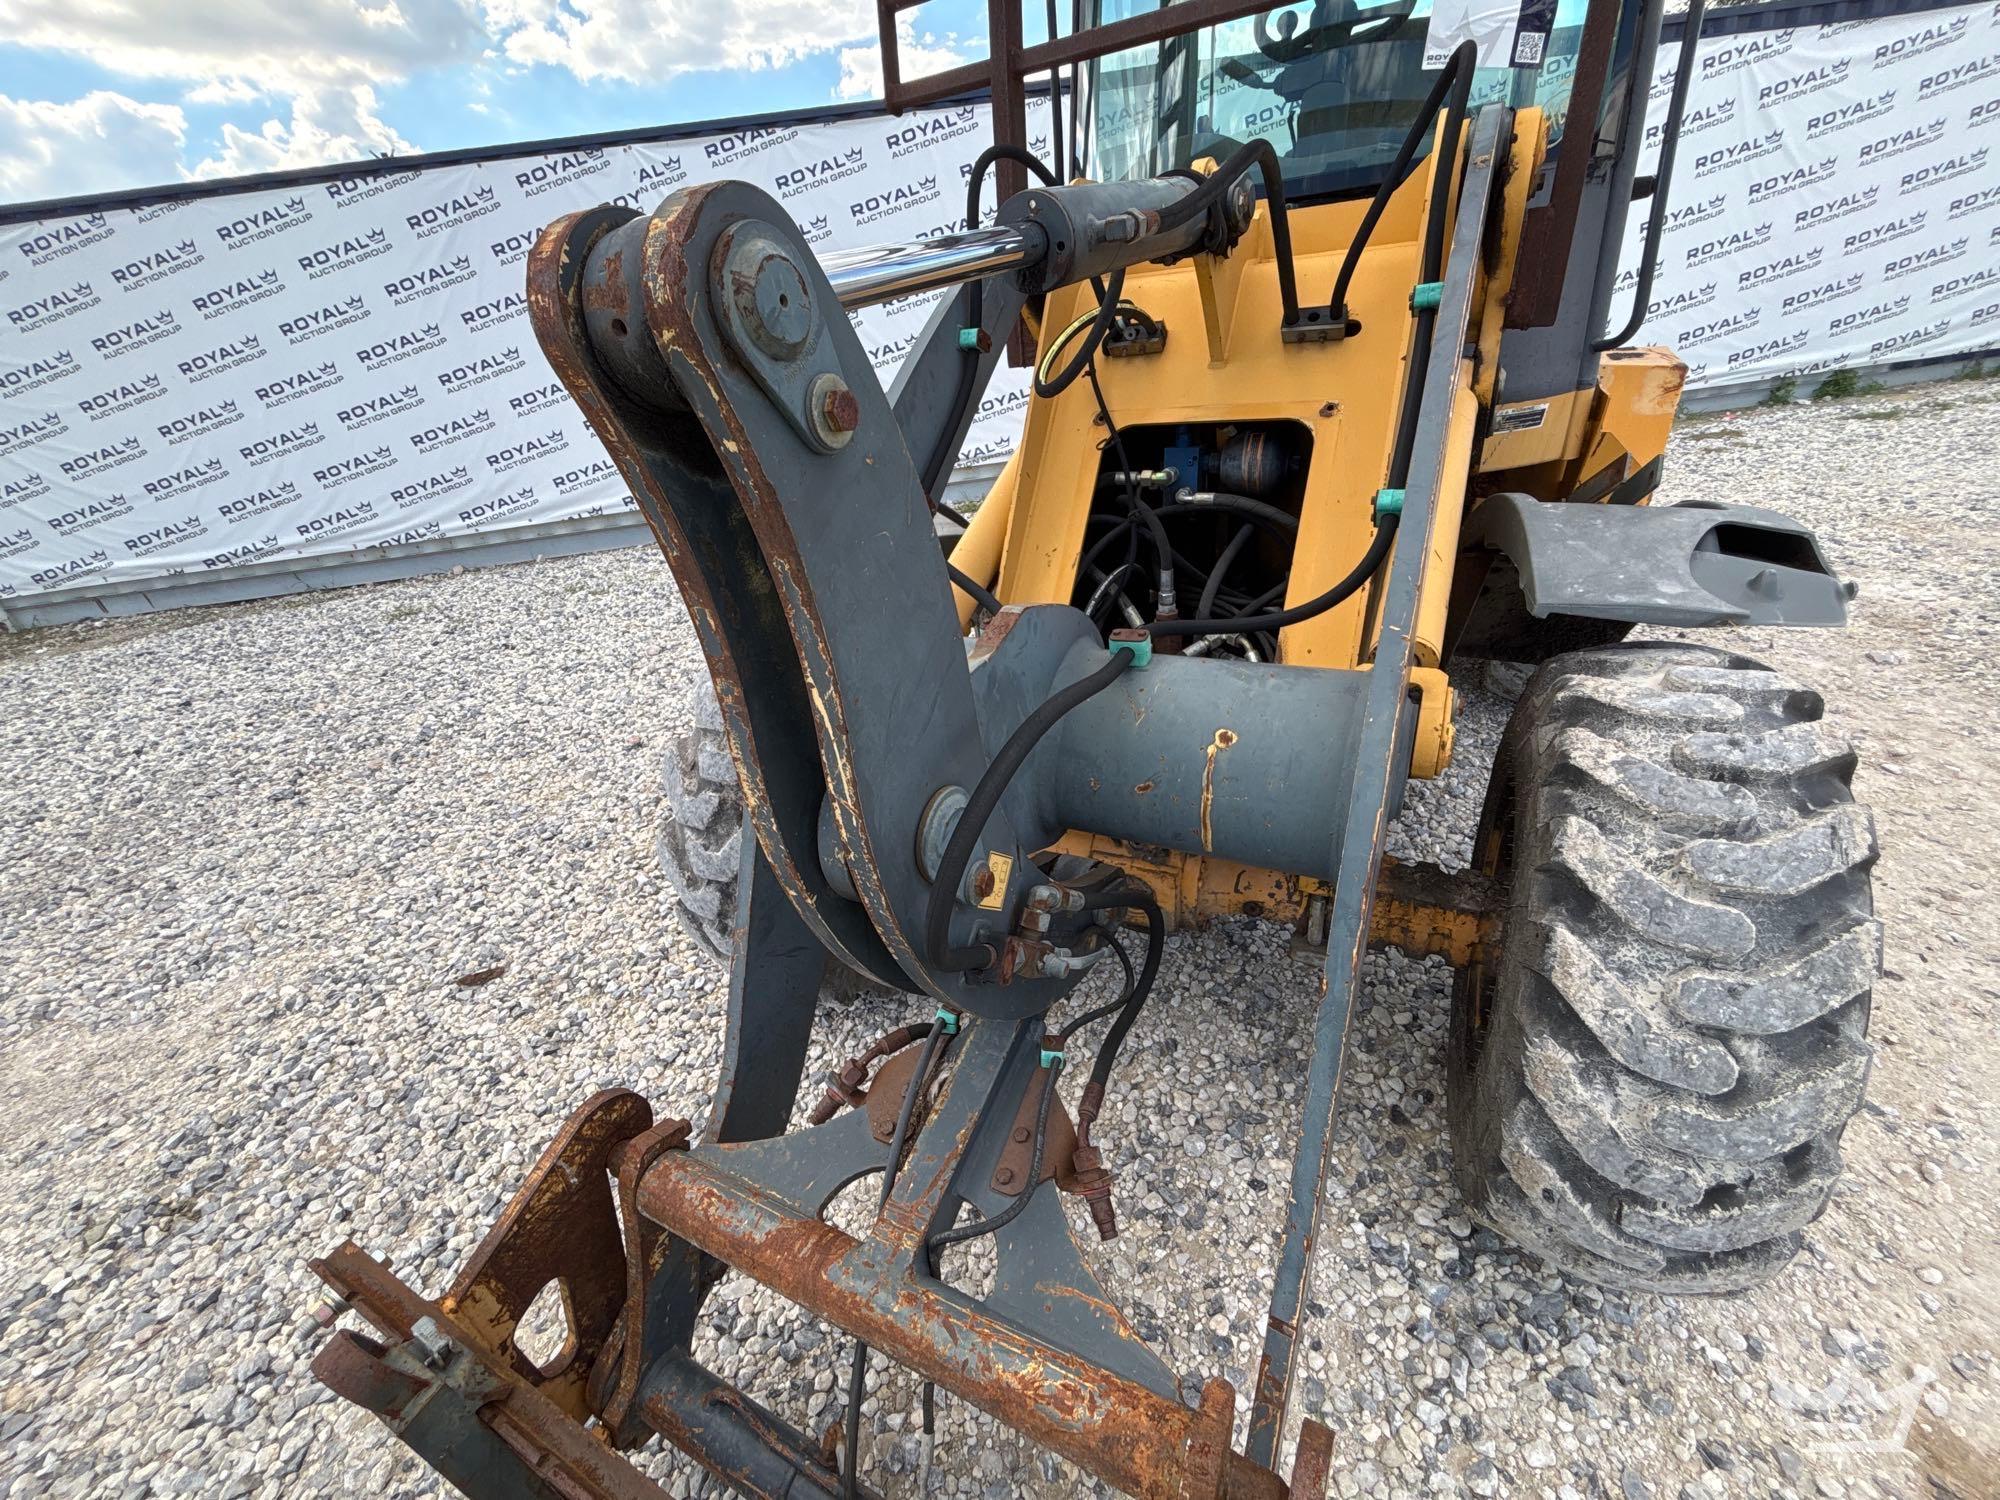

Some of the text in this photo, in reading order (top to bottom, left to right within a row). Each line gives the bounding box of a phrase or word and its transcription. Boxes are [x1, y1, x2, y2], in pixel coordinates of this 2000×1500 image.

[1702, 44, 1793, 81] AUCTION GROUP
[1703, 39, 1774, 71] ROYAL
[1758, 74, 1850, 111] AUCTION GROUP
[1760, 68, 1830, 101] ROYAL
[1245, 101, 1300, 128] ROYA
[1247, 118, 1287, 139] AUCTIO
[1806, 105, 1896, 141] AUCTION GROUP
[1808, 100, 1877, 131] ROYAL
[886, 115, 957, 149] ROYAL
[892, 122, 978, 159] AUCTION GROUP
[1860, 128, 1926, 158] ROYAL
[1695, 144, 1782, 179] AUCTION GROUP
[1696, 139, 1764, 170] ROYAL
[1858, 133, 1944, 168] AUCTION GROUP
[516, 154, 588, 188] ROYAL
[525, 160, 610, 197] AUCTION GROUP
[775, 156, 846, 190] ROYAL
[782, 163, 867, 199] AUCTION GROUP
[1750, 166, 1819, 196] ROYAL
[1899, 162, 1986, 196] AUCTION GROUP
[1901, 157, 1969, 187] ROYAL
[850, 184, 920, 217] ROYAL
[1748, 171, 1837, 205] AUCTION GROUP
[216, 207, 289, 241] ROYAL
[406, 195, 478, 230] ROYAL
[416, 202, 501, 239] AUCTION GROUP
[856, 191, 940, 226] AUCTION GROUP
[1795, 199, 1879, 233] AUCTION GROUP
[1796, 195, 1862, 224] ROYAL
[19, 222, 91, 257] ROYAL
[32, 228, 115, 266] AUCTION GROUP
[228, 213, 312, 250] AUCTION GROUP
[1687, 232, 1753, 260] ROYAL
[1843, 224, 1925, 257] AUCTION GROUP
[1844, 220, 1908, 248] ROYAL
[111, 249, 181, 284] ROYAL
[298, 237, 370, 271] ROYAL
[309, 244, 393, 280] AUCTION GROUP
[1686, 236, 1772, 269] AUCTION GROUP
[1883, 250, 1967, 282] AUCTION GROUP
[1885, 246, 1950, 274] ROYAL
[123, 255, 204, 292] AUCTION GROUP
[384, 264, 455, 297] ROYAL
[1738, 260, 1823, 292] AUCTION GROUP
[1739, 256, 1805, 284] ROYAL
[192, 278, 263, 311] ROYAL
[203, 284, 285, 320] AUCTION GROUP
[394, 270, 477, 306] AUCTION GROUP
[1781, 285, 1862, 317] AUCTION GROUP
[1783, 281, 1846, 309] ROYAL
[7, 291, 78, 325] ROYAL
[20, 297, 101, 333] AUCTION GROUP
[278, 304, 348, 336] ROYAL
[1828, 308, 1909, 338] AUCTION GROUP
[1830, 304, 1892, 330] ROYAL
[91, 319, 160, 352] ROYAL
[103, 324, 182, 360] AUCTION GROUP
[289, 310, 371, 345] AUCTION GROUP
[1678, 320, 1760, 351] AUCTION GROUP
[1679, 316, 1743, 343] ROYAL
[177, 344, 245, 375] ROYAL
[356, 332, 425, 363] ROYAL
[366, 337, 447, 371] AUCTION GROUP
[1727, 341, 1808, 372] AUCTION GROUP
[1728, 338, 1792, 364] ROYAL
[189, 349, 266, 383] AUCTION GROUP
[438, 356, 505, 386] ROYAL
[447, 360, 526, 394] AUCTION GROUP
[78, 382, 146, 413] ROYAL
[255, 370, 322, 401] ROYAL
[265, 375, 344, 409] AUCTION GROUP
[90, 388, 168, 421] AUCTION GROUP
[337, 393, 404, 423] ROYAL
[347, 398, 425, 431] AUCTION GROUP
[158, 408, 223, 438] ROYAL
[169, 413, 244, 445] AUCTION GROUP
[410, 417, 475, 447] ROYAL
[419, 422, 496, 454] AUCTION GROUP
[60, 445, 126, 474] ROYAL
[239, 430, 304, 459] ROYAL
[250, 435, 325, 467] AUCTION GROUP
[486, 438, 550, 466] ROYAL
[494, 442, 569, 474] AUCTION GROUP
[71, 449, 147, 482] AUCTION GROUP
[143, 466, 208, 495] ROYAL
[313, 454, 377, 482] ROYAL
[323, 458, 398, 490] AUCTION GROUP
[154, 470, 229, 502] AUCTION GROUP
[390, 474, 453, 502] ROYAL
[399, 478, 473, 509] AUCTION GROUP
[48, 502, 113, 530] ROYAL
[218, 489, 282, 517] ROYAL
[228, 493, 302, 524] AUCTION GROUP
[459, 495, 520, 522] ROYAL
[466, 499, 539, 529] AUCTION GROUP
[59, 506, 134, 537] AUCTION GROUP
[124, 524, 187, 551] ROYAL
[296, 509, 359, 536] ROYAL
[305, 513, 378, 543] AUCTION GROUP
[135, 528, 208, 557] AUCTION GROUP
